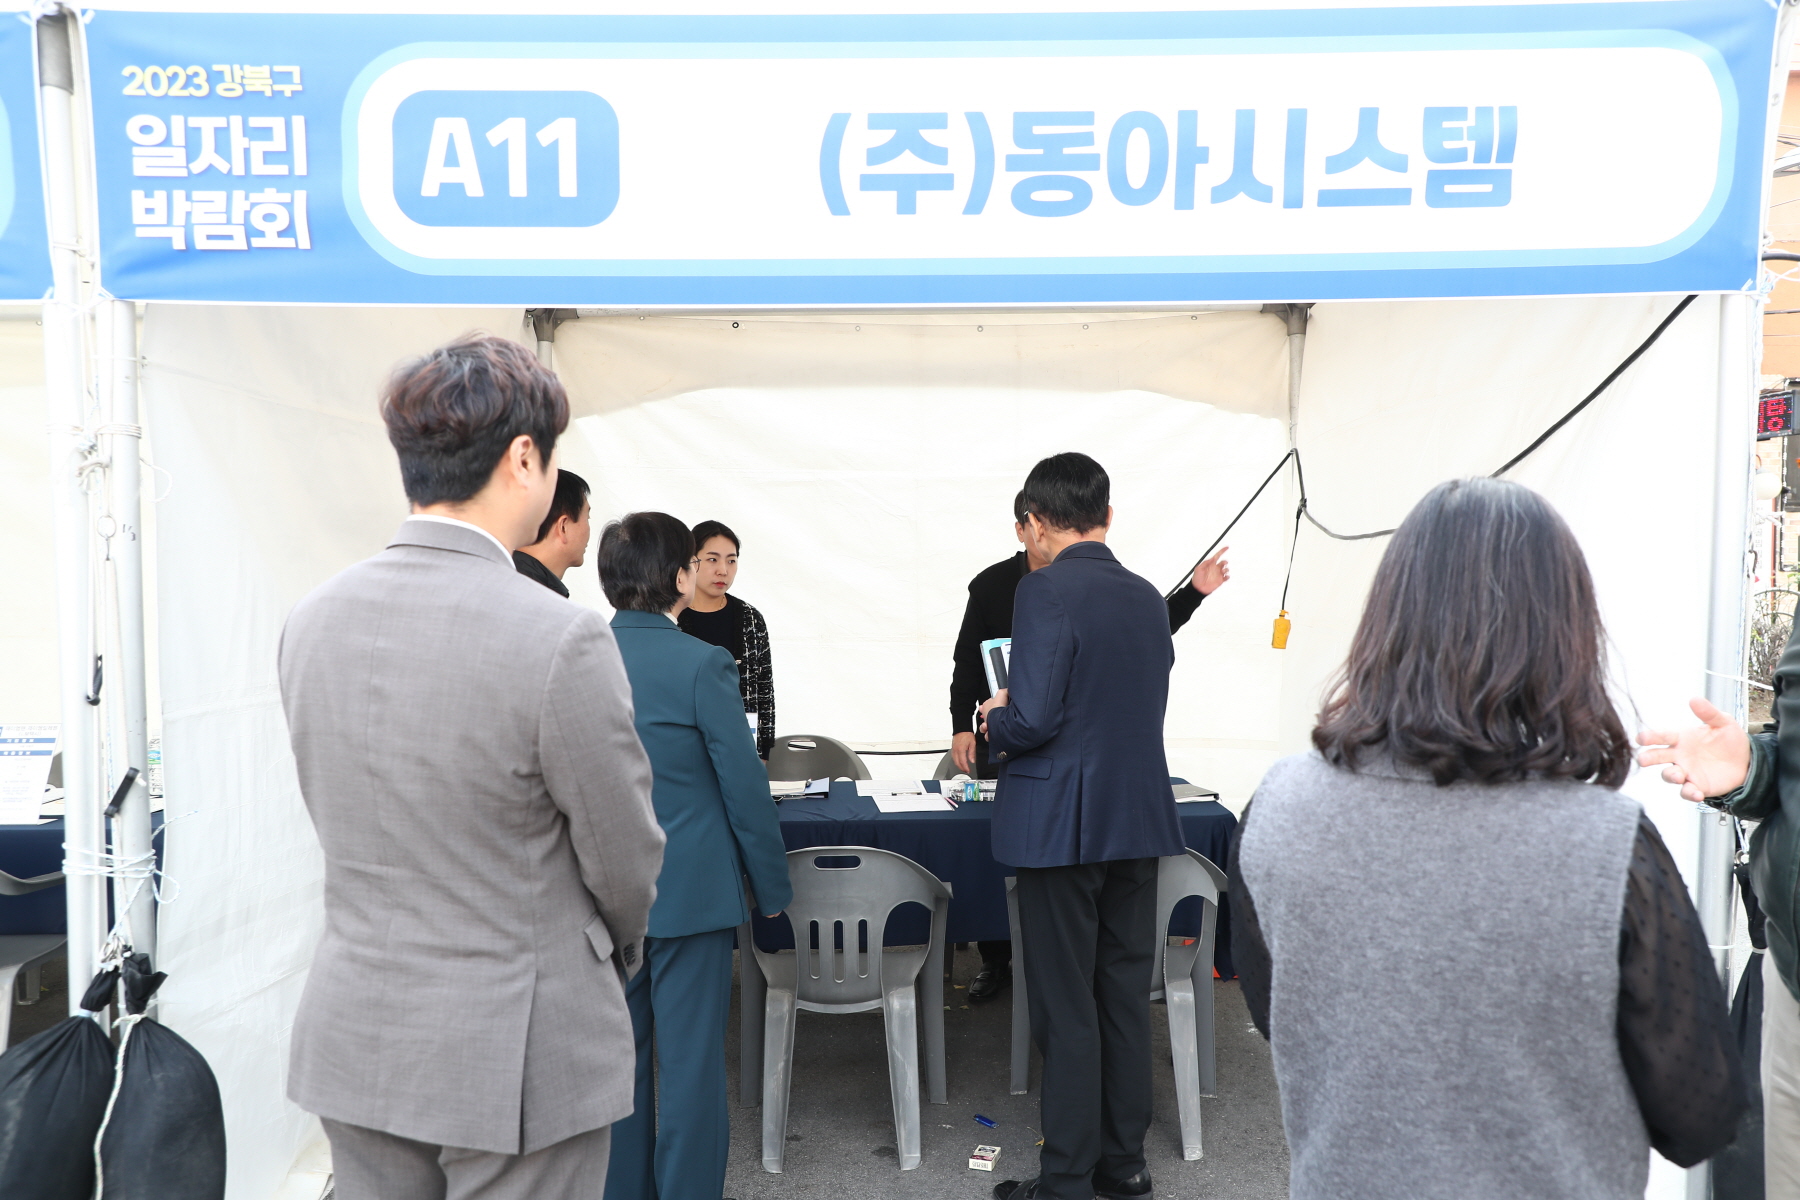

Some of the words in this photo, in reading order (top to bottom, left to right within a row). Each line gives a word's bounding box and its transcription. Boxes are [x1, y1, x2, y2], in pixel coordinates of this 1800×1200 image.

[121, 64, 210, 98] 2023
[212, 64, 303, 98] 강북구
[125, 114, 308, 177] 일자리
[420, 116, 578, 198] A11
[818, 105, 1520, 217] (주)동아시스템
[132, 188, 312, 251] 박람회
